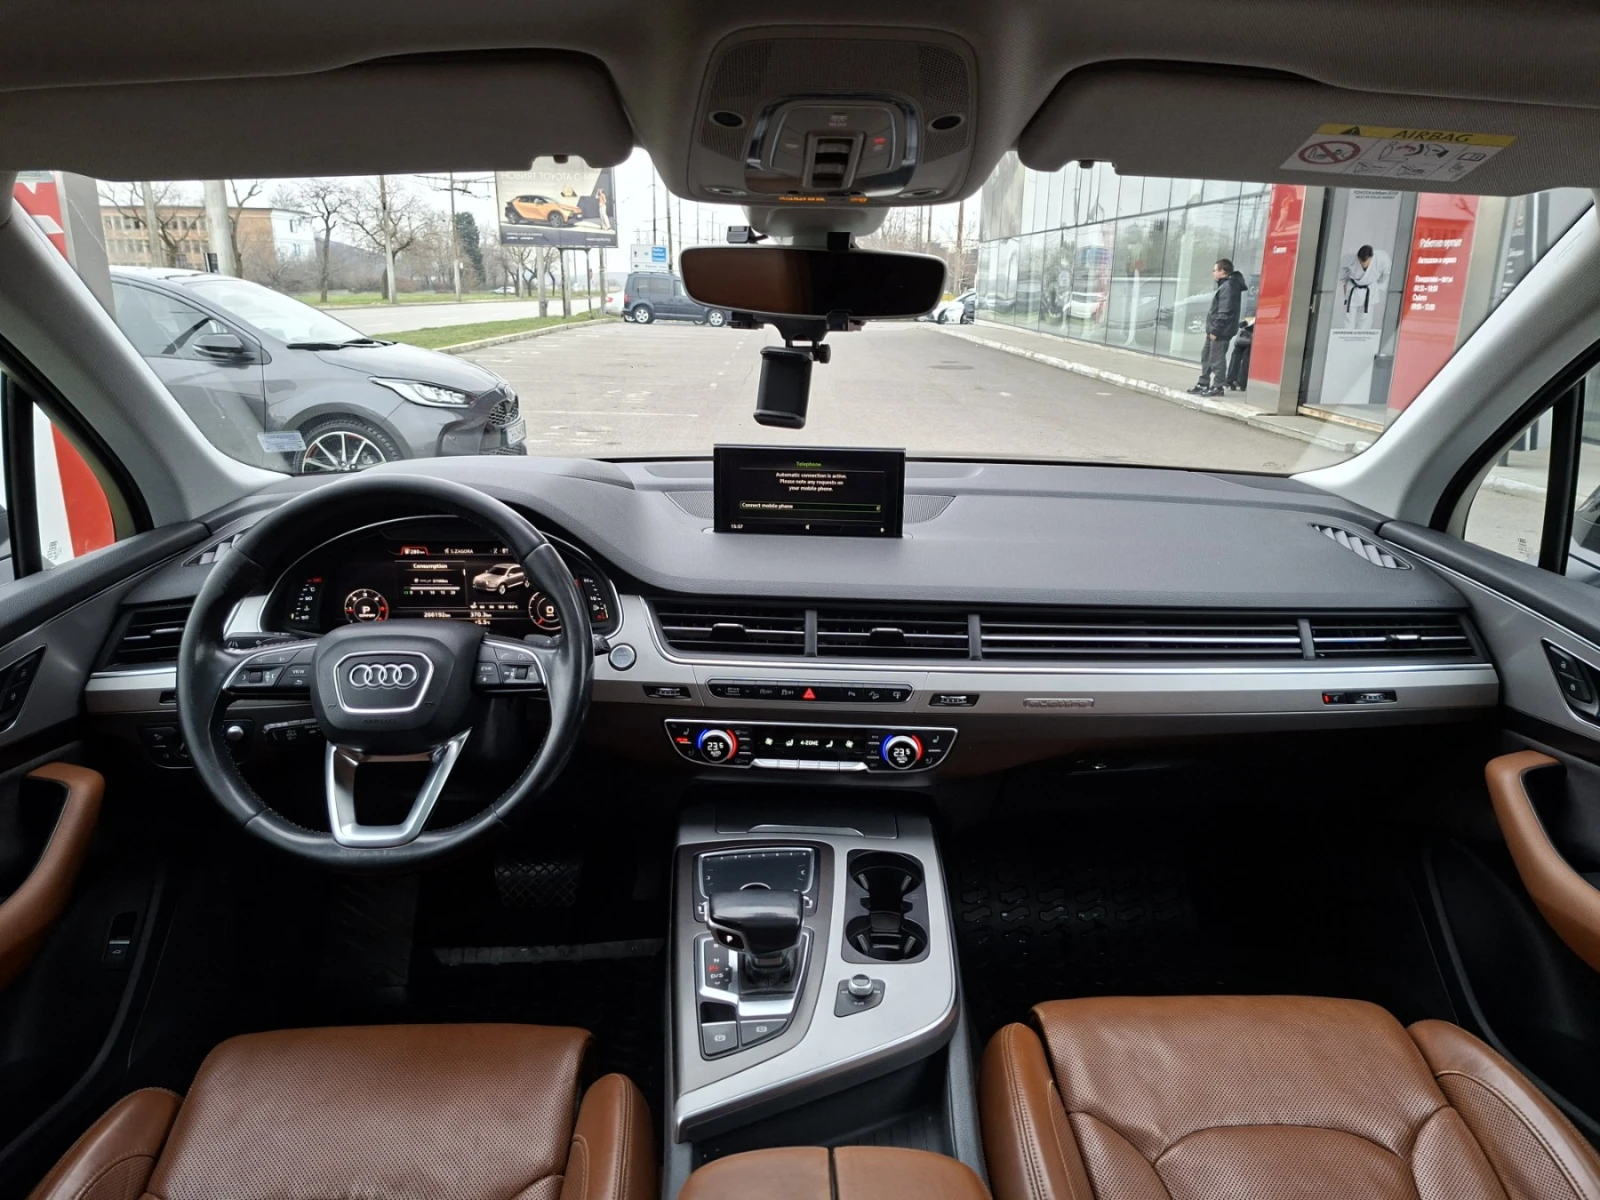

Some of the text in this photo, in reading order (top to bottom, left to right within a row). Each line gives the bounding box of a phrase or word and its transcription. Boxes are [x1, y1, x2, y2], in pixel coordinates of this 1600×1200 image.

[1392, 129, 1474, 143] AIRBAG
[539, 172, 572, 181] TOYOTA
[362, 606, 371, 614] P
[726, 935, 733, 943] P
